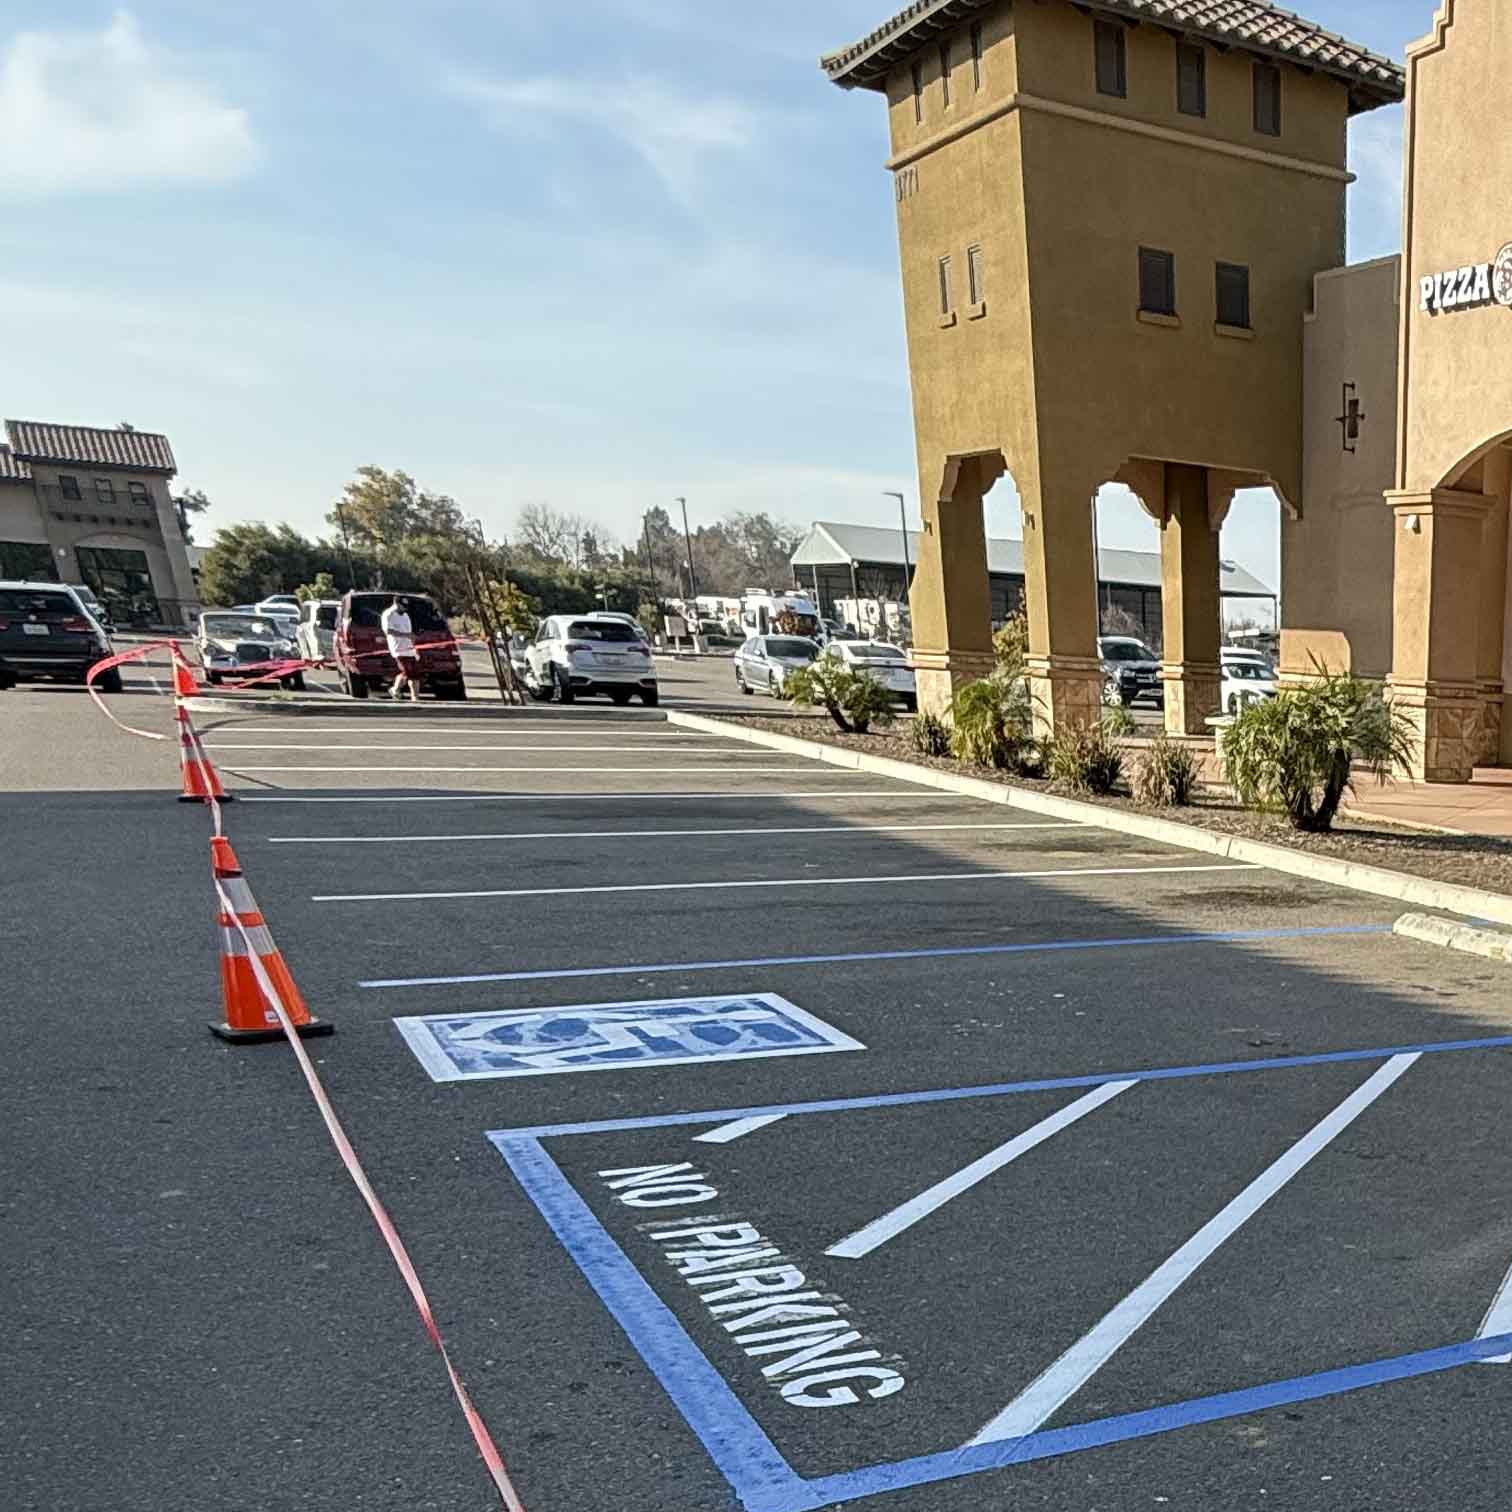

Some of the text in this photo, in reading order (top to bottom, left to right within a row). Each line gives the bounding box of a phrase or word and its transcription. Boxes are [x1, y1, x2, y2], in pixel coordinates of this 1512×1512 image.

[1419, 263, 1491, 312] PIZZA
[597, 1162, 905, 1407] NO PARKING
